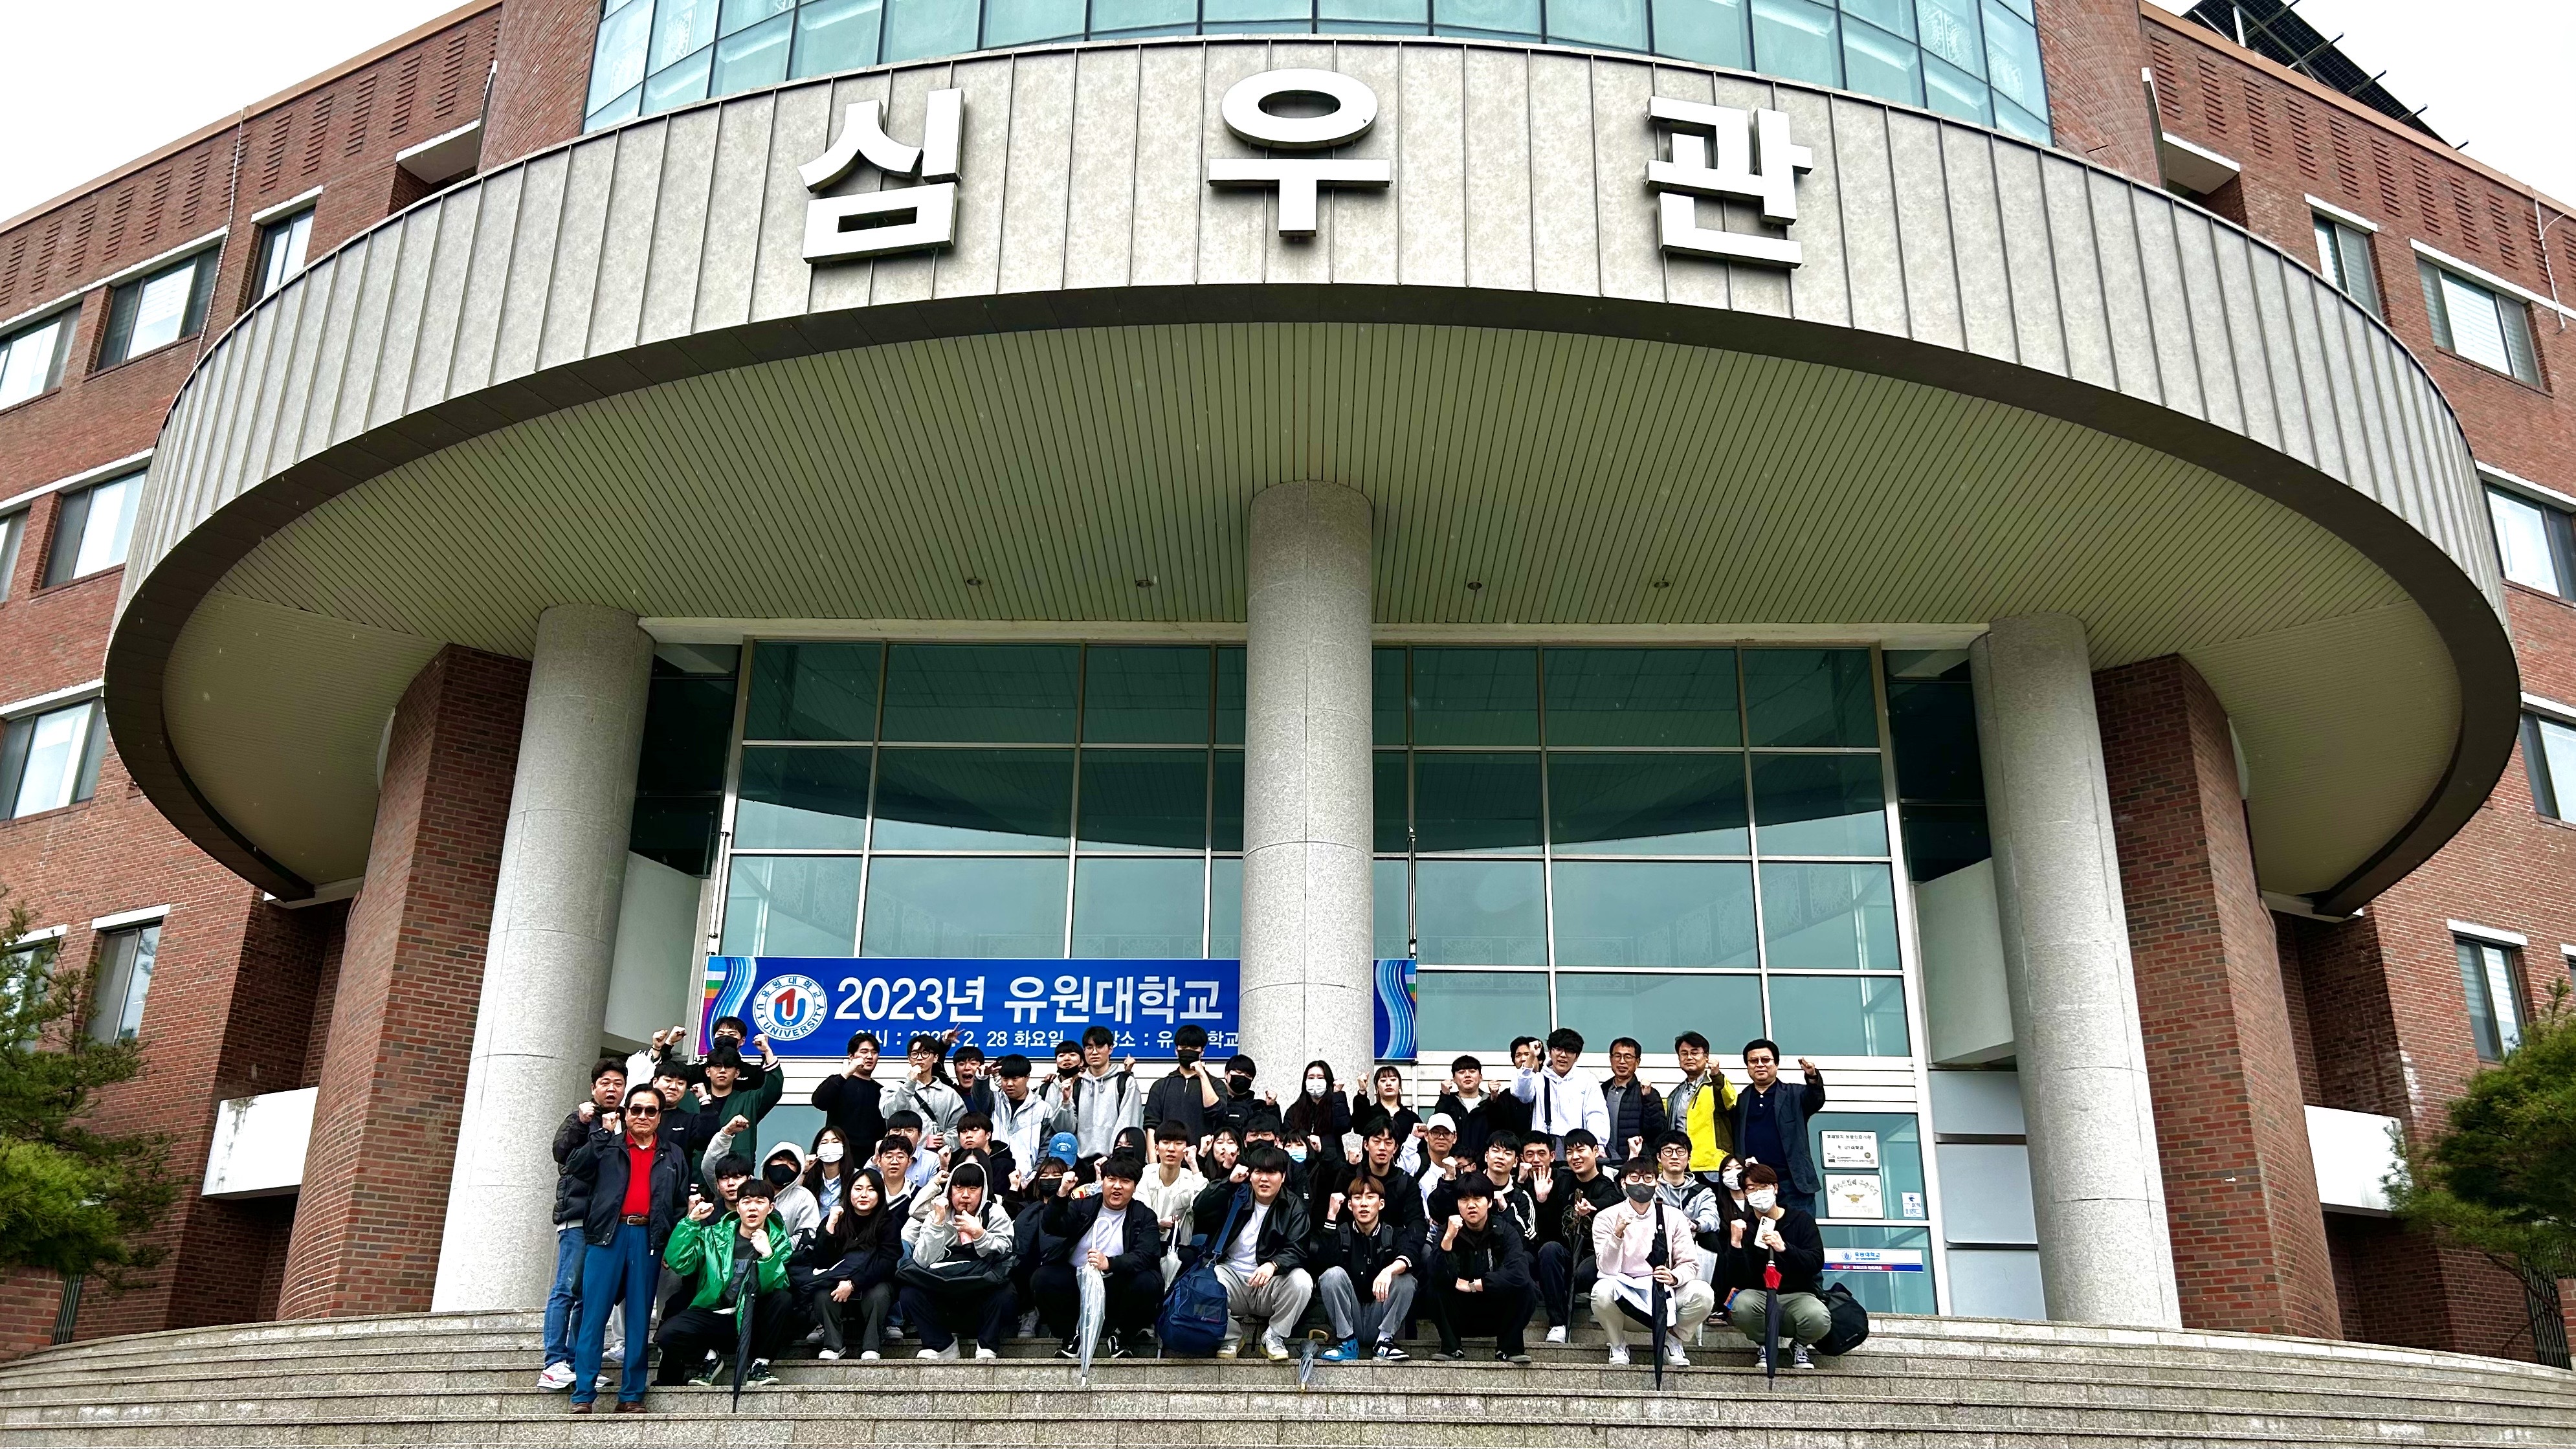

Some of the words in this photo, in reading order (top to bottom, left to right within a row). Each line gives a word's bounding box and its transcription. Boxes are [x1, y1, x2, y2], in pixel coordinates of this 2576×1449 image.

[797, 68, 1812, 265] 심우관
[761, 977, 822, 999] 유원대학교
[834, 976, 984, 1023] 2023년
[1005, 976, 1223, 1024] 유원대학교
[763, 1004, 825, 1037] UNIVERSITY
[856, 1030, 888, 1047] 시
[986, 1030, 1008, 1047] 28
[1013, 1030, 1063, 1048] 화요일
[1157, 1030, 1239, 1048] 유학교
